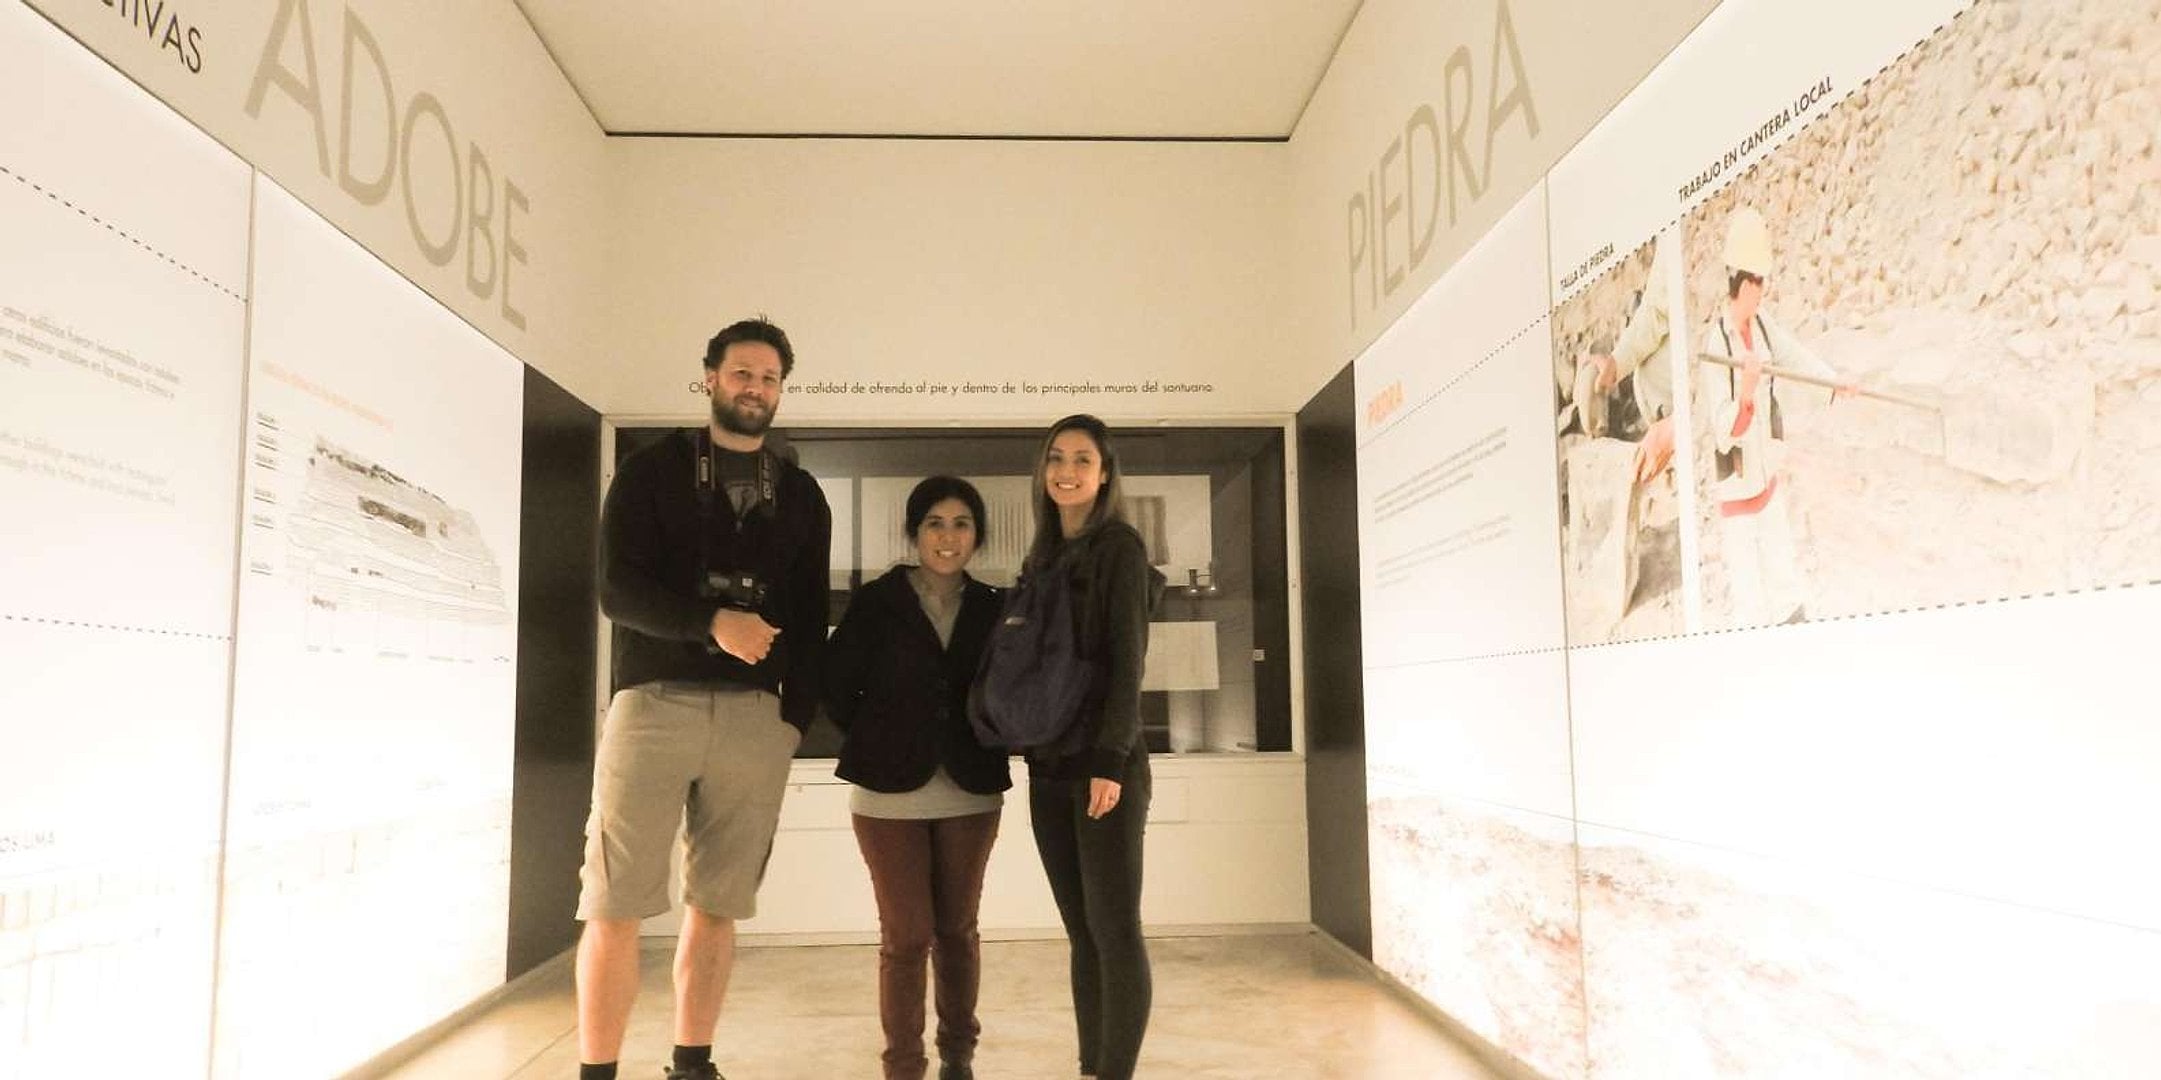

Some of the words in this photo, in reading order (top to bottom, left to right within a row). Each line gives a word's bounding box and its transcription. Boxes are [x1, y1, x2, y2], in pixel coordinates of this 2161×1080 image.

[244, 0, 530, 331] ADOBE
[1348, 0, 1540, 331] PIEDRA
[1678, 161, 1721, 203] TRABAJO
[1723, 147, 1738, 170] EN
[1740, 109, 1791, 156] CANTERA
[1794, 76, 1834, 117] LOCAL
[788, 384, 802, 394] en
[806, 381, 847, 394] calidad
[851, 381, 866, 394] de
[869, 381, 913, 394] ofrenda
[916, 381, 926, 393] al
[930, 382, 948, 396] pie
[951, 384, 959, 396] y
[962, 381, 998, 394] dentro
[1002, 381, 1016, 393] de
[1022, 381, 1038, 393] los
[1041, 381, 1100, 394] principales
[1104, 383, 1138, 393] muros
[1141, 380, 1158, 393] del
